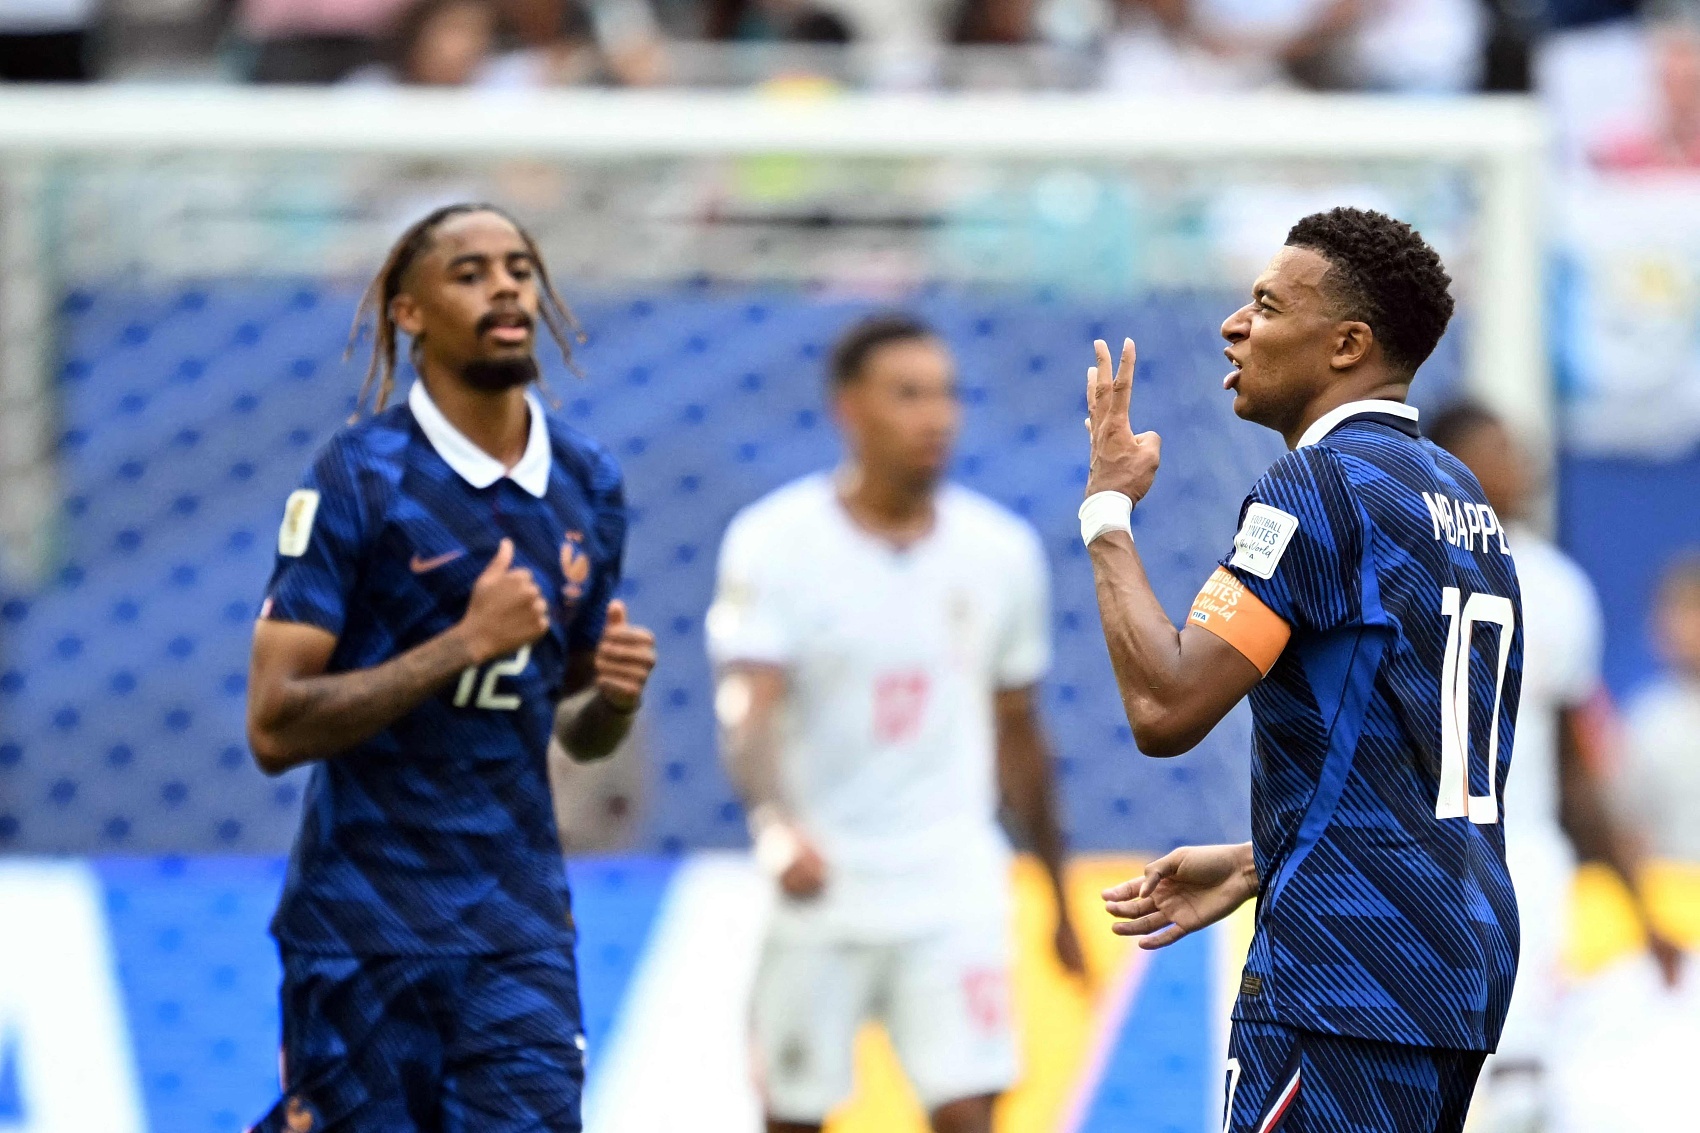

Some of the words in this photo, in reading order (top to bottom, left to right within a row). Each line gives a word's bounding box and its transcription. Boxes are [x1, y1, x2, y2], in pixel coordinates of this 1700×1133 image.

[1250, 514, 1282, 534] FOOTBALL
[1200, 580, 1242, 606] ITES
[1209, 570, 1245, 593] TBALL
[1192, 611, 1207, 621] FIFA
[1435, 586, 1515, 825] 10
